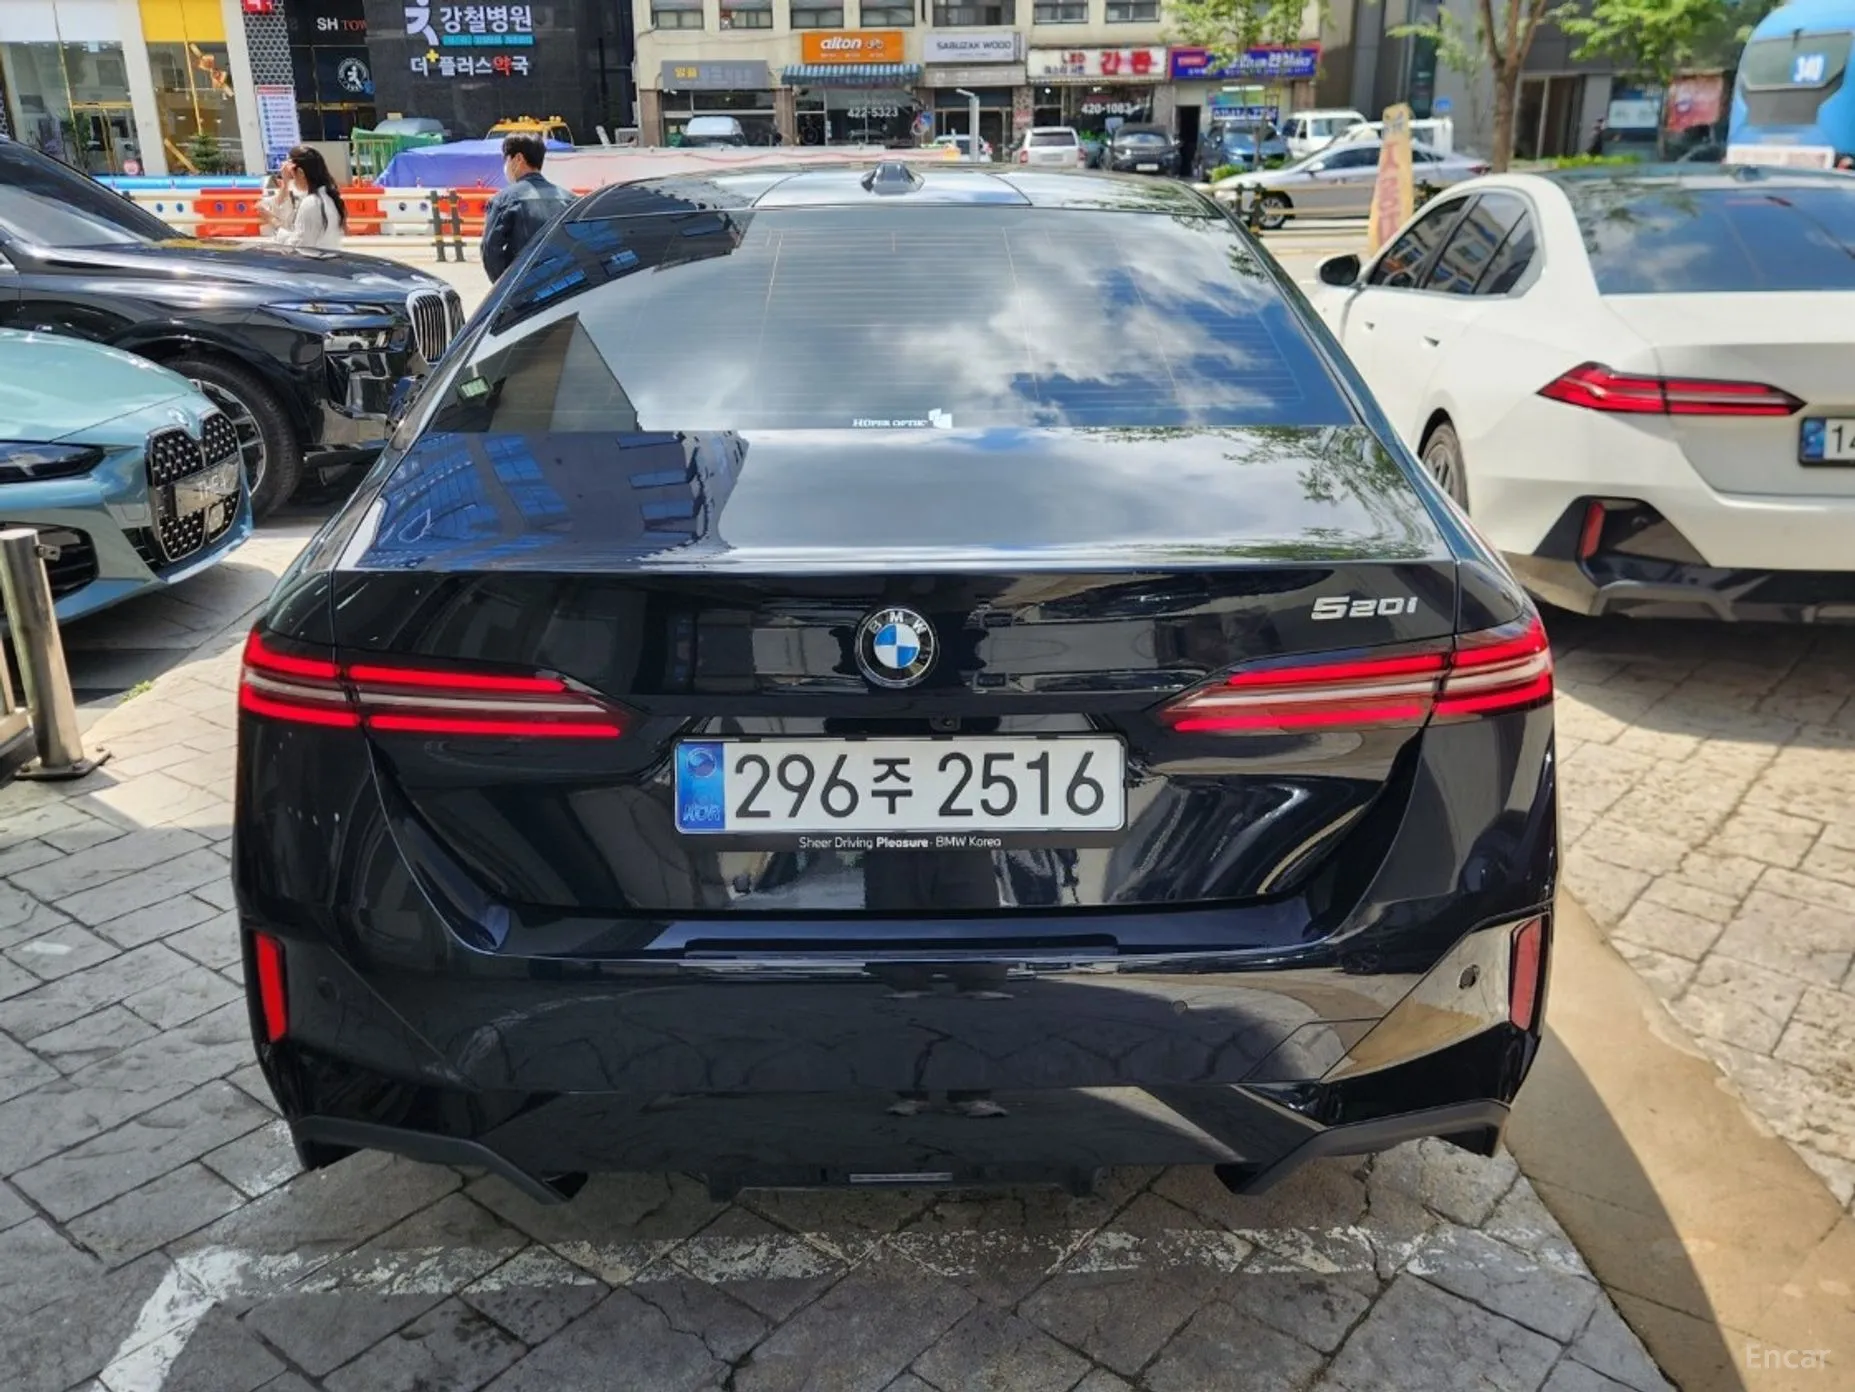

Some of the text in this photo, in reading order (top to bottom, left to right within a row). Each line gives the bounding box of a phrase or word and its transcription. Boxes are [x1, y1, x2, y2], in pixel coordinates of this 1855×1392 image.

[316, 17, 339, 31] SH
[440, 4, 533, 34] 강철병원
[820, 36, 862, 50] alton
[982, 41, 1012, 49] WOOD
[938, 751, 1105, 817] 2516
[799, 835, 1001, 850] Sheer Driving Pleasure BMW Korea
